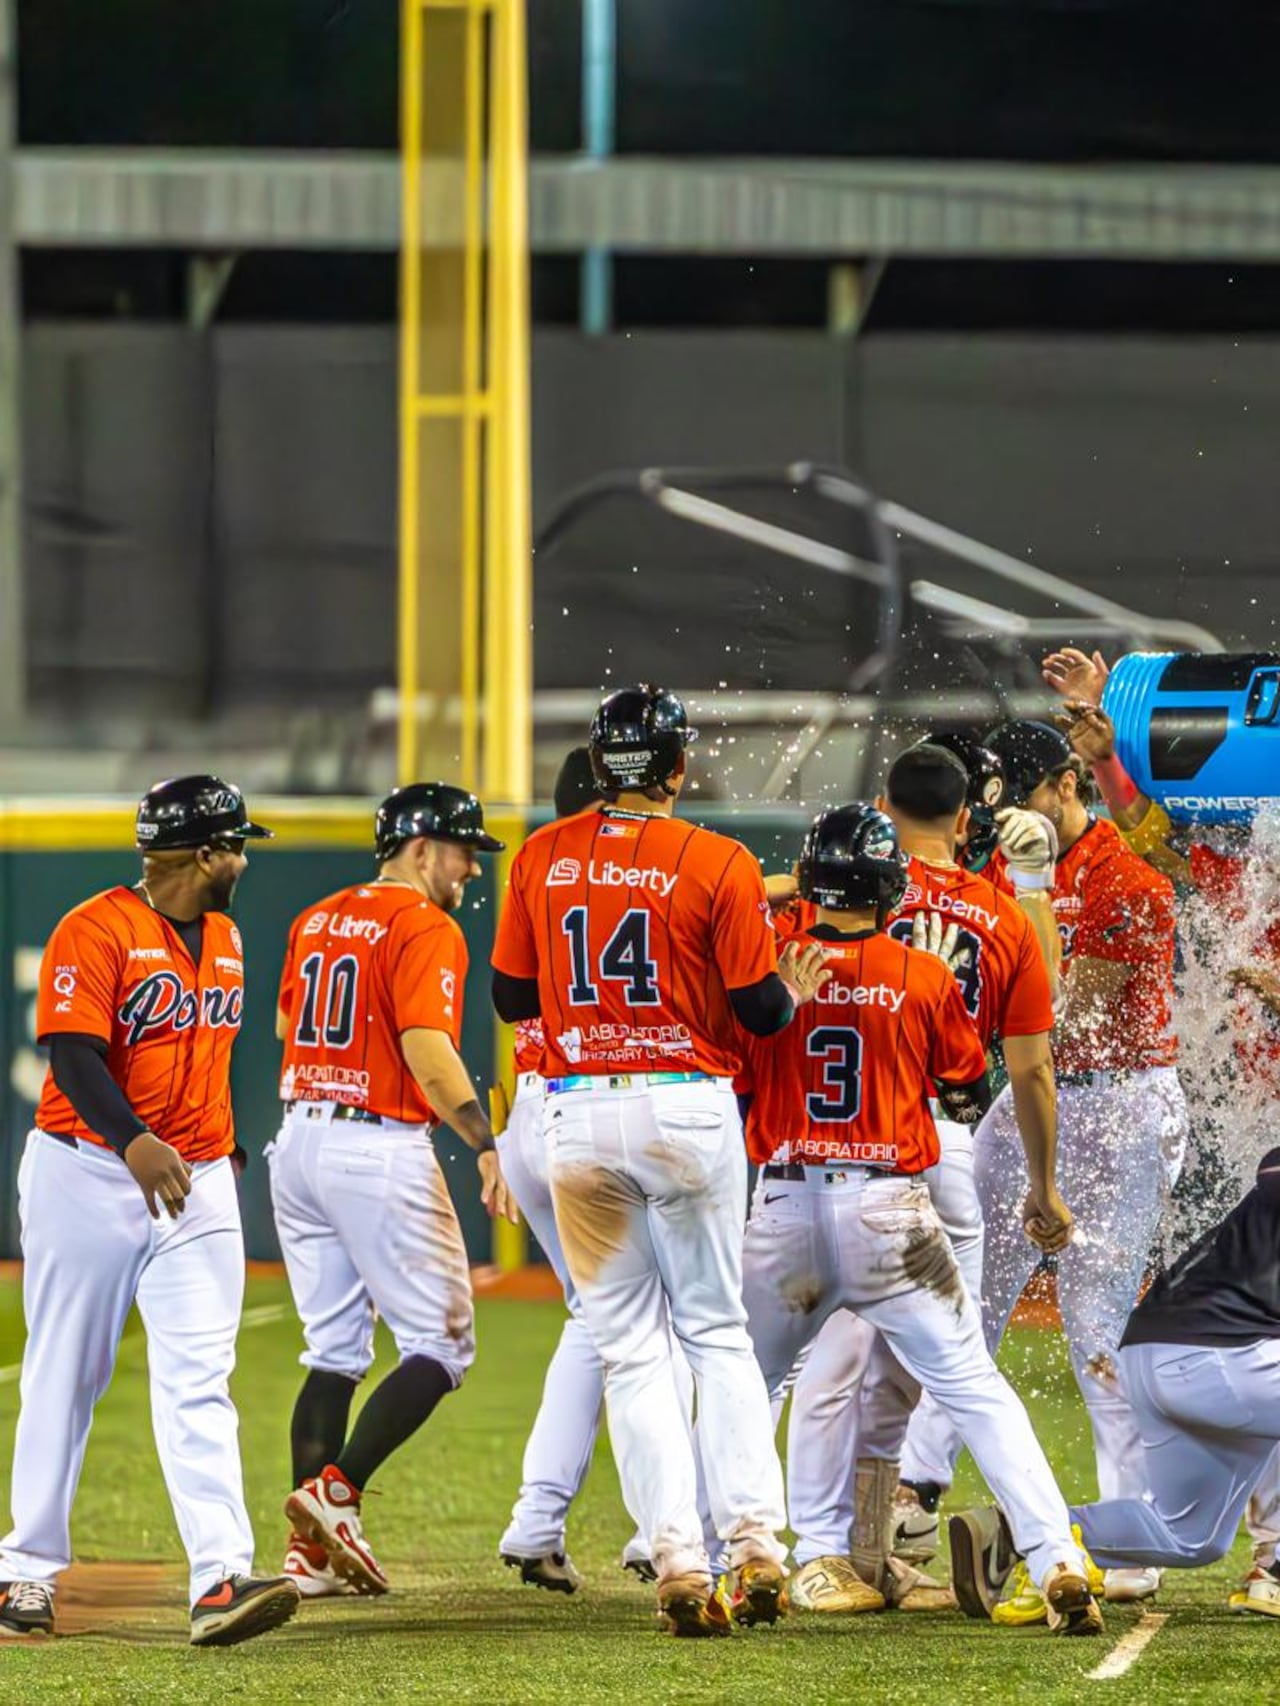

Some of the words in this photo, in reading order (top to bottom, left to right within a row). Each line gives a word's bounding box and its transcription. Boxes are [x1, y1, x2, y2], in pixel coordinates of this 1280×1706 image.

[587, 859, 679, 897] Liberty
[294, 951, 359, 1050] 10
[561, 905, 662, 1007] 14
[805, 1025, 864, 1123] 3
